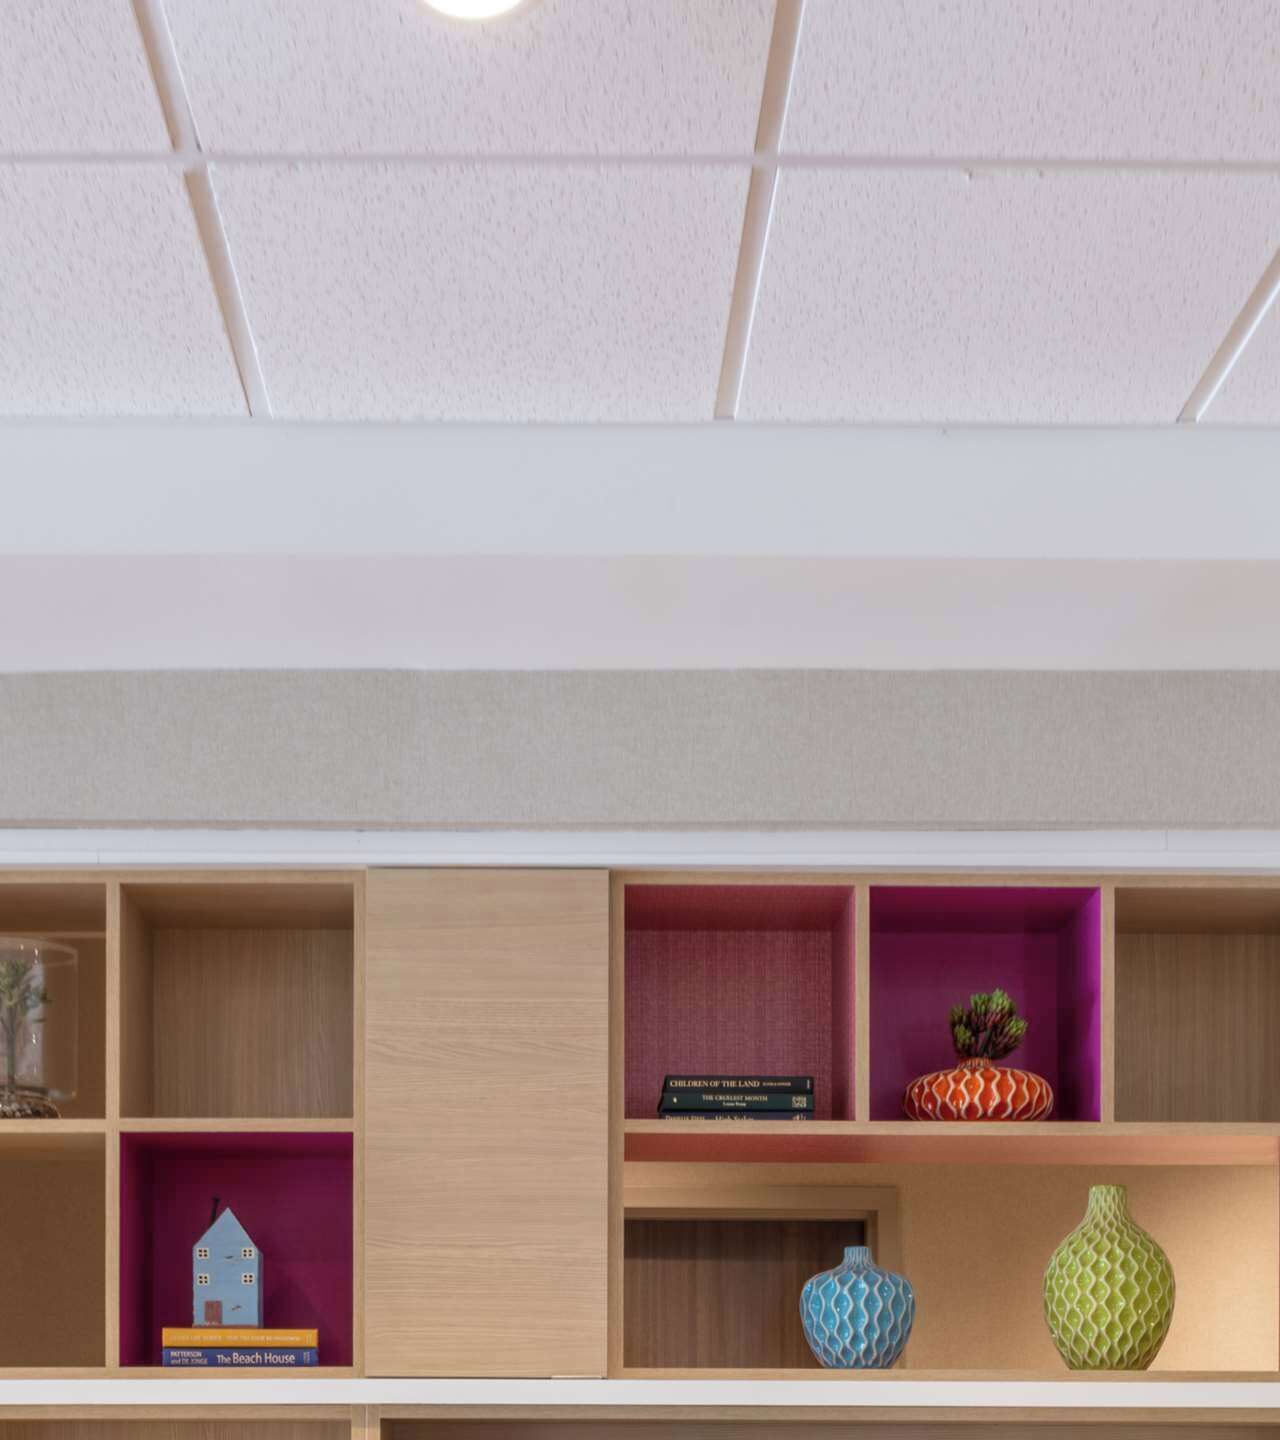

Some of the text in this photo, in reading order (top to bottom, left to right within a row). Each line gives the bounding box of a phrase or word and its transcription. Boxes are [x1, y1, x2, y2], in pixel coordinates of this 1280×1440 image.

[669, 1079, 709, 1088] CHILDREN
[709, 1079, 720, 1088] OF
[721, 1079, 737, 1088] THE
[738, 1079, 761, 1088] LAND
[216, 1354, 231, 1363] The
[232, 1352, 262, 1364] Beach
[264, 1352, 296, 1364] House
